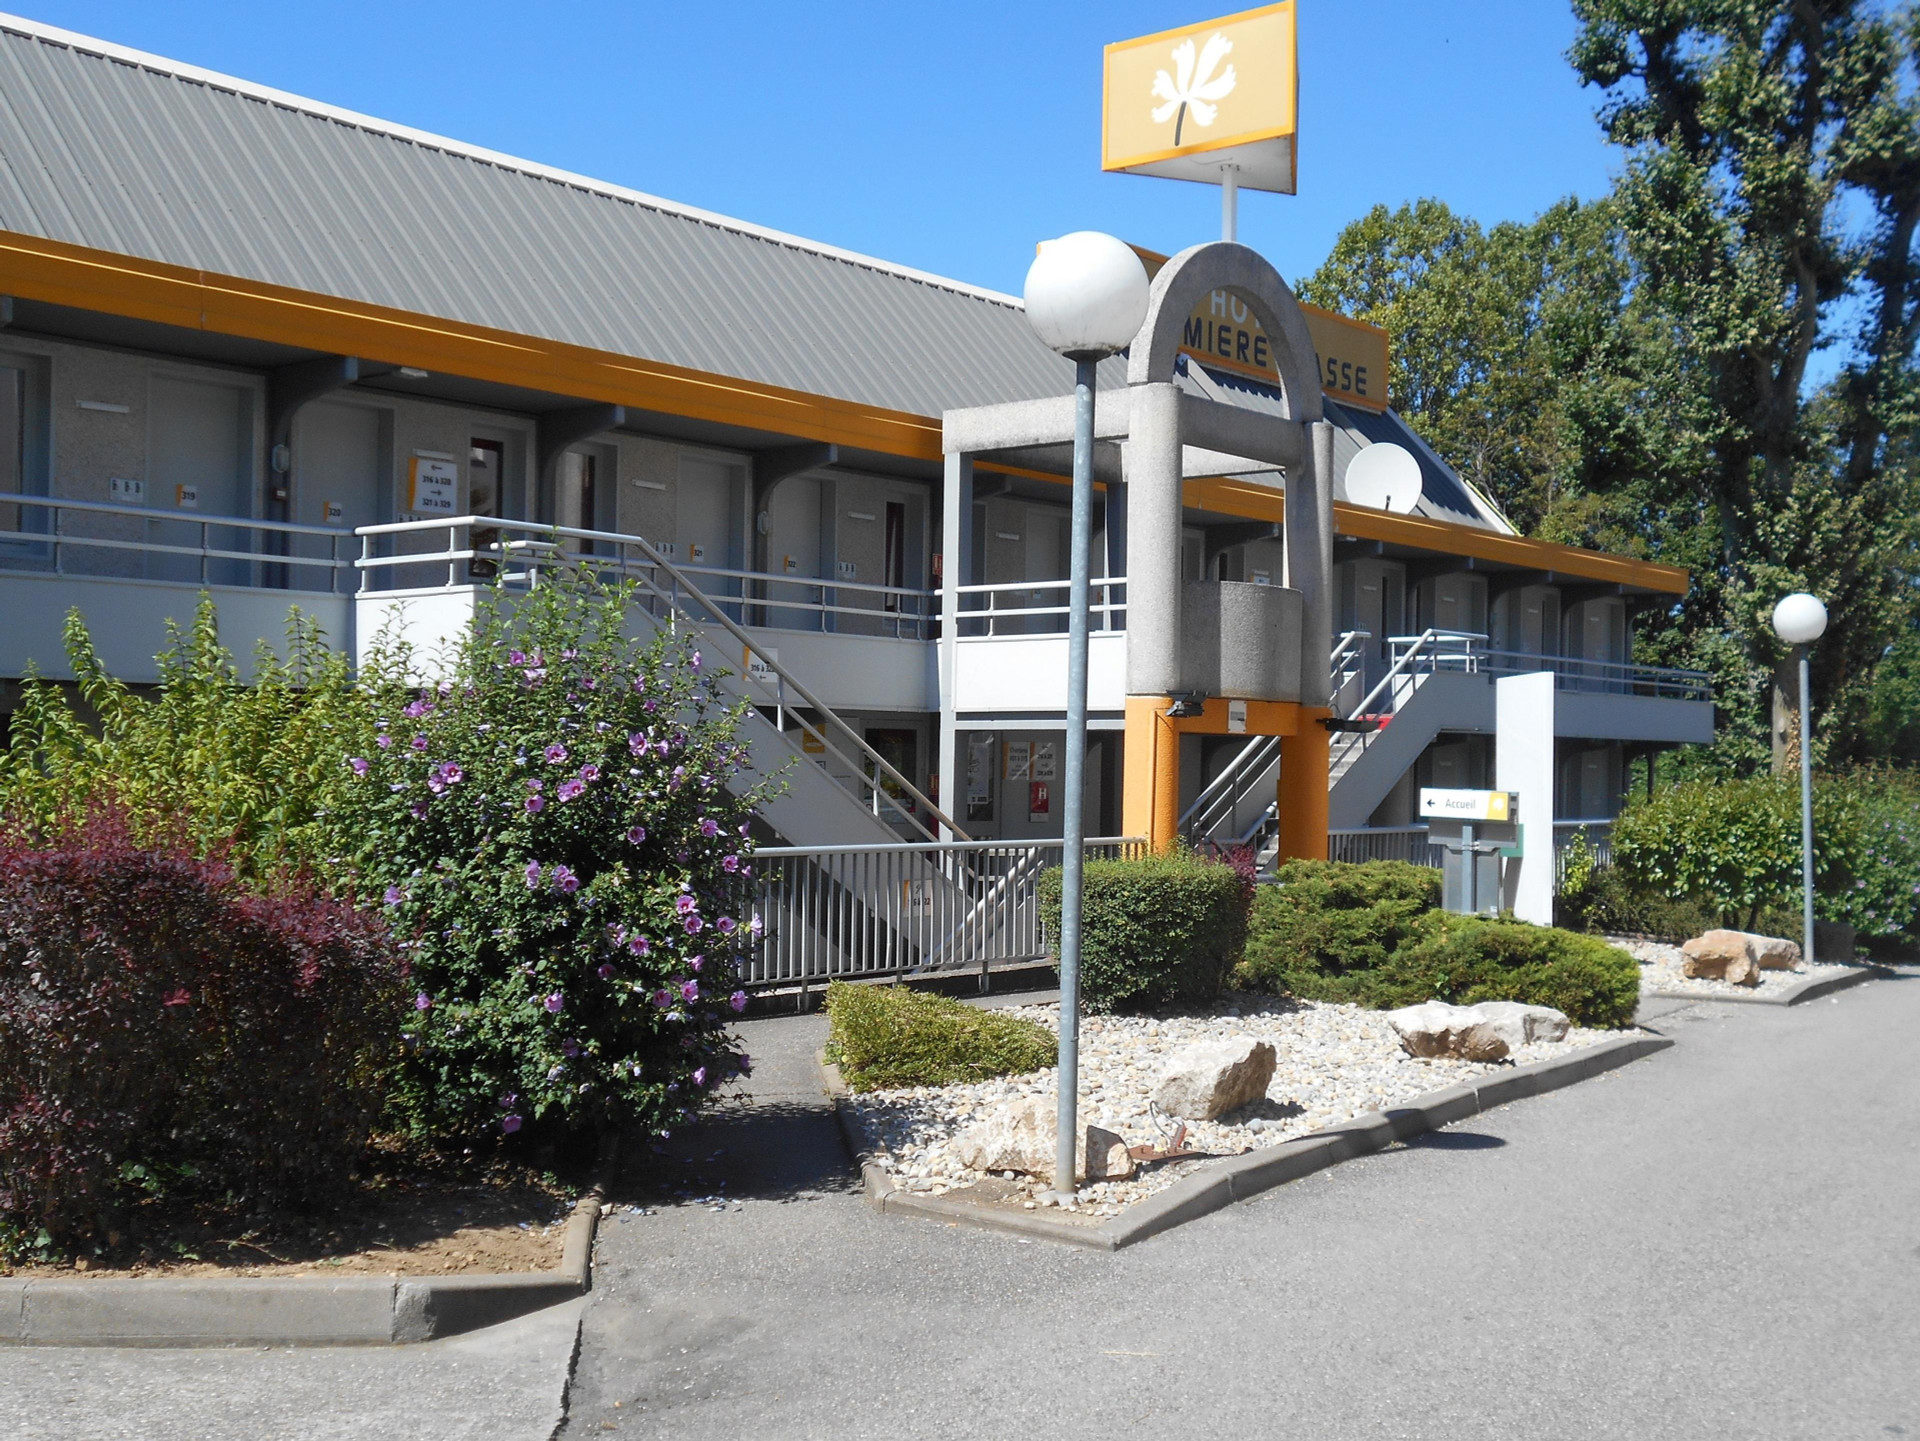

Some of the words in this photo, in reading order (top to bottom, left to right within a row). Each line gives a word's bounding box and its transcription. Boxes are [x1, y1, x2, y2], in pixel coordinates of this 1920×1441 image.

[1211, 290, 1260, 328] HO
[181, 490, 196, 501] 319
[422, 498, 433, 506] 321
[1445, 798, 1476, 809] Accueil
